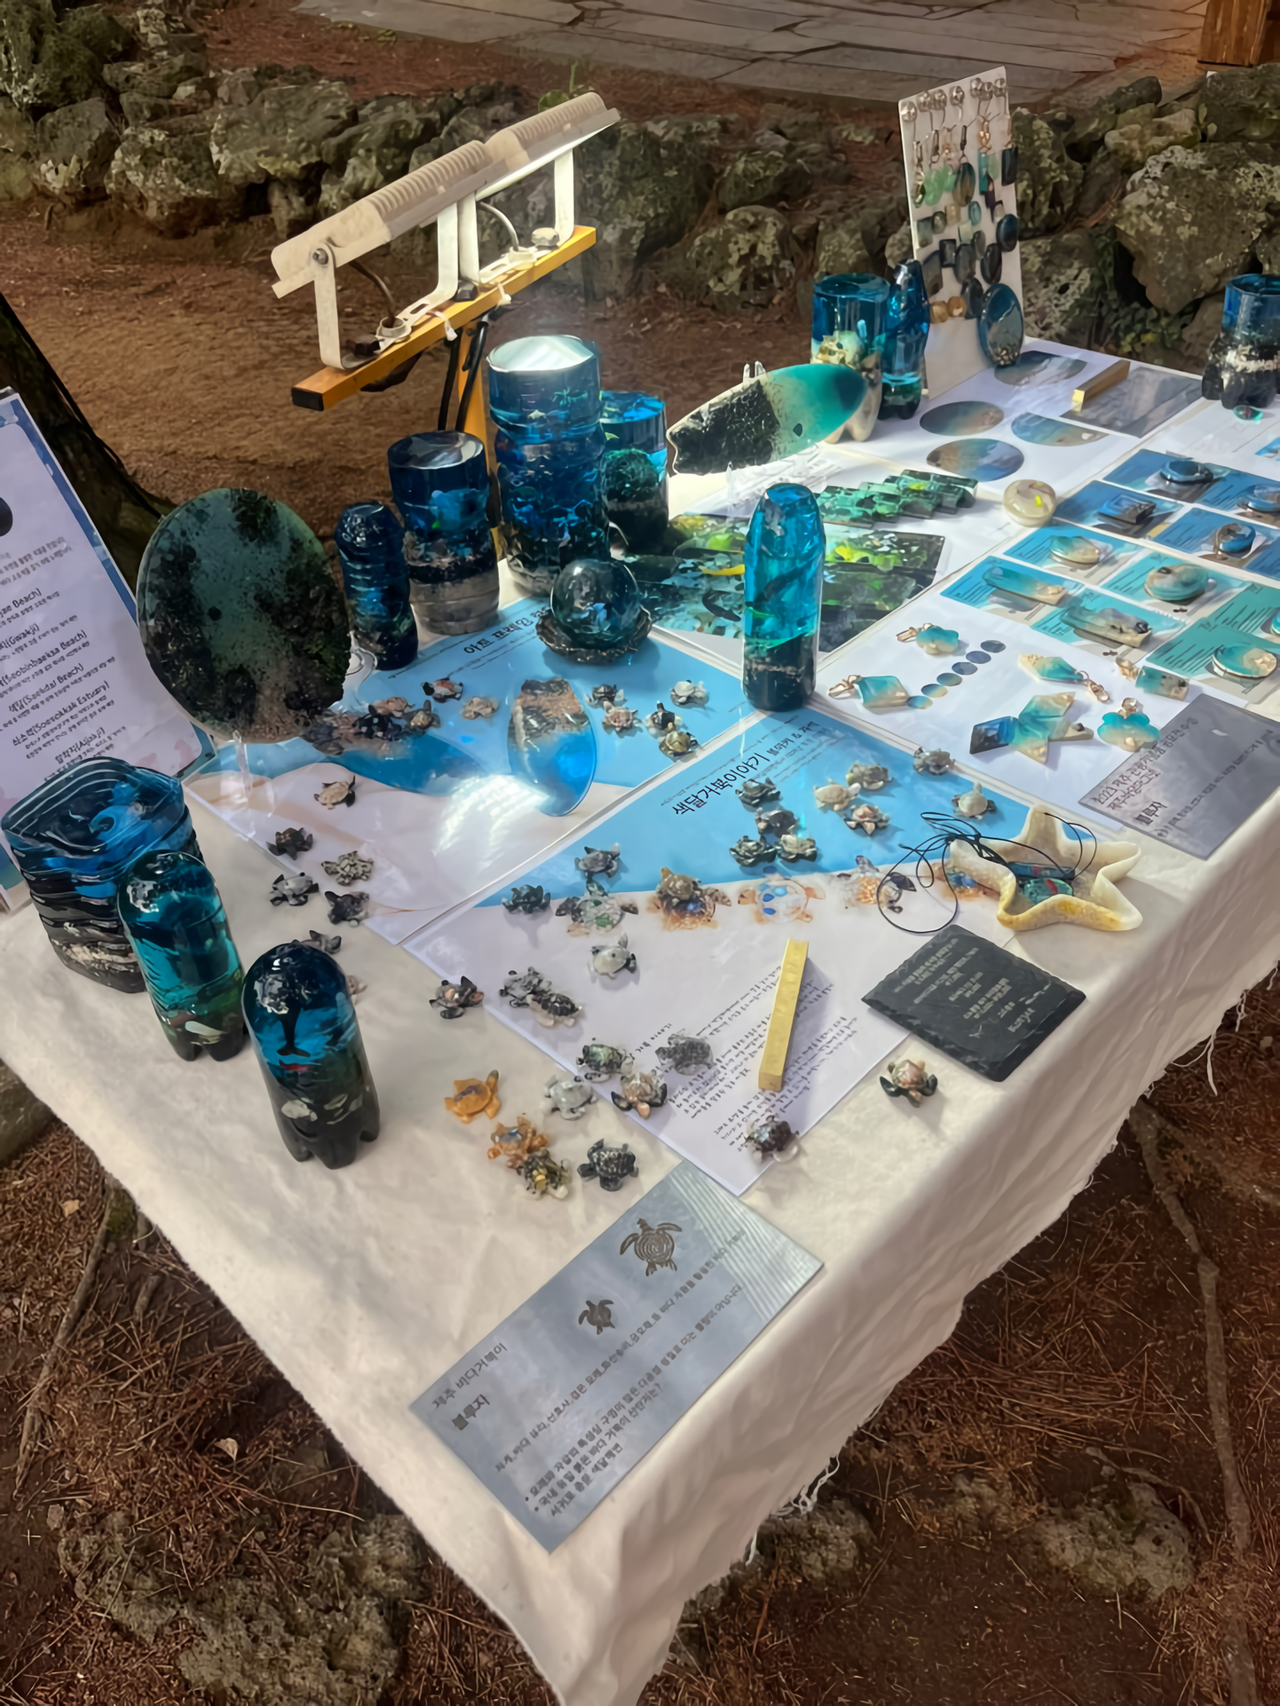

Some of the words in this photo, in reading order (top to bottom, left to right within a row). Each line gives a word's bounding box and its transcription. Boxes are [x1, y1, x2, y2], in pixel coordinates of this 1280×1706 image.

[671, 750, 770, 818] 색달거북이야기
[431, 1386, 457, 1410] 제주
[454, 1342, 507, 1390] 바다거북이
